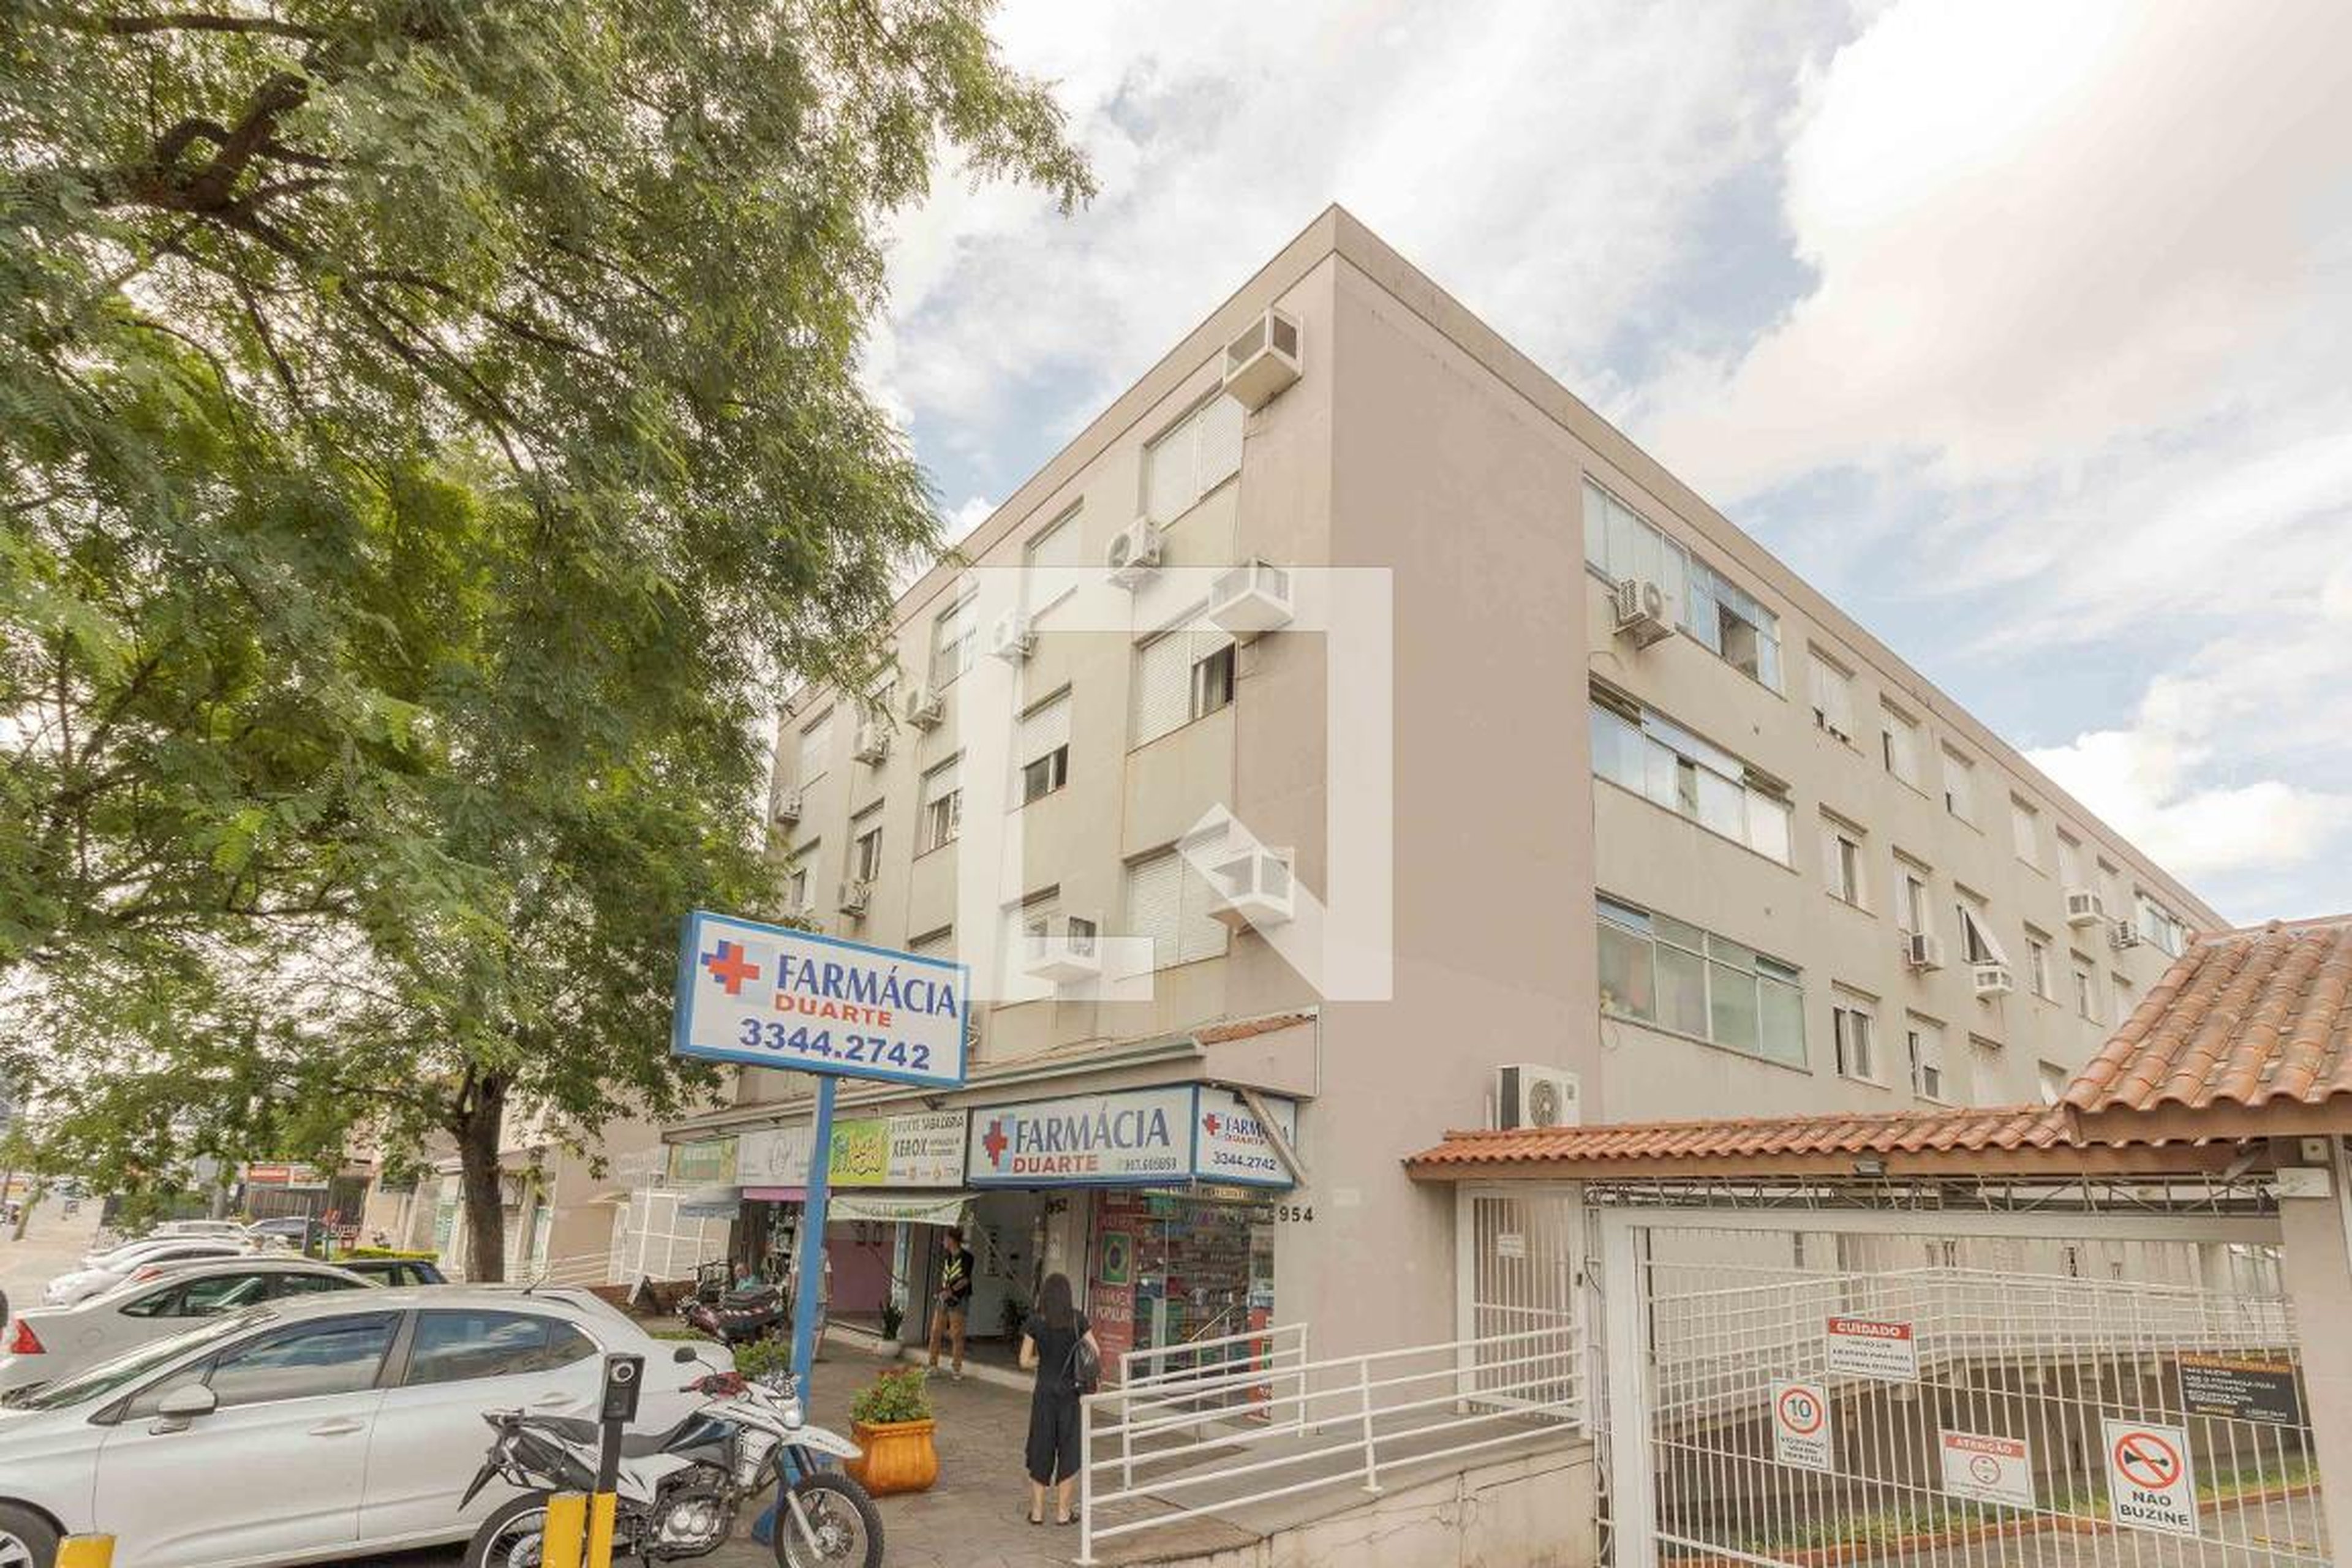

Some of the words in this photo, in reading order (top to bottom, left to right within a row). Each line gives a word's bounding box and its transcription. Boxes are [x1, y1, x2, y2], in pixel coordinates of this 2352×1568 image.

[776, 954, 957, 1019] FARMÁCIA
[774, 993, 892, 1028] DUARTE
[739, 1018, 931, 1071] 3344.2742
[1015, 1099, 1170, 1153] FARMÁCIA
[1226, 1116, 1289, 1140] FARMA
[892, 1137, 928, 1158] XEROX
[1012, 1154, 1099, 1174] DUARTE
[1212, 1150, 1277, 1172] 3344.2742
[1278, 1205, 1314, 1224] 954
[1836, 1322, 1901, 1337] CUIDADO
[1787, 1398, 1812, 1418] 10
[1954, 1438, 2013, 1455] ATENÇÃO
[2131, 1490, 2171, 1507] NÃO
[2120, 1504, 2191, 1527] BUZINE
